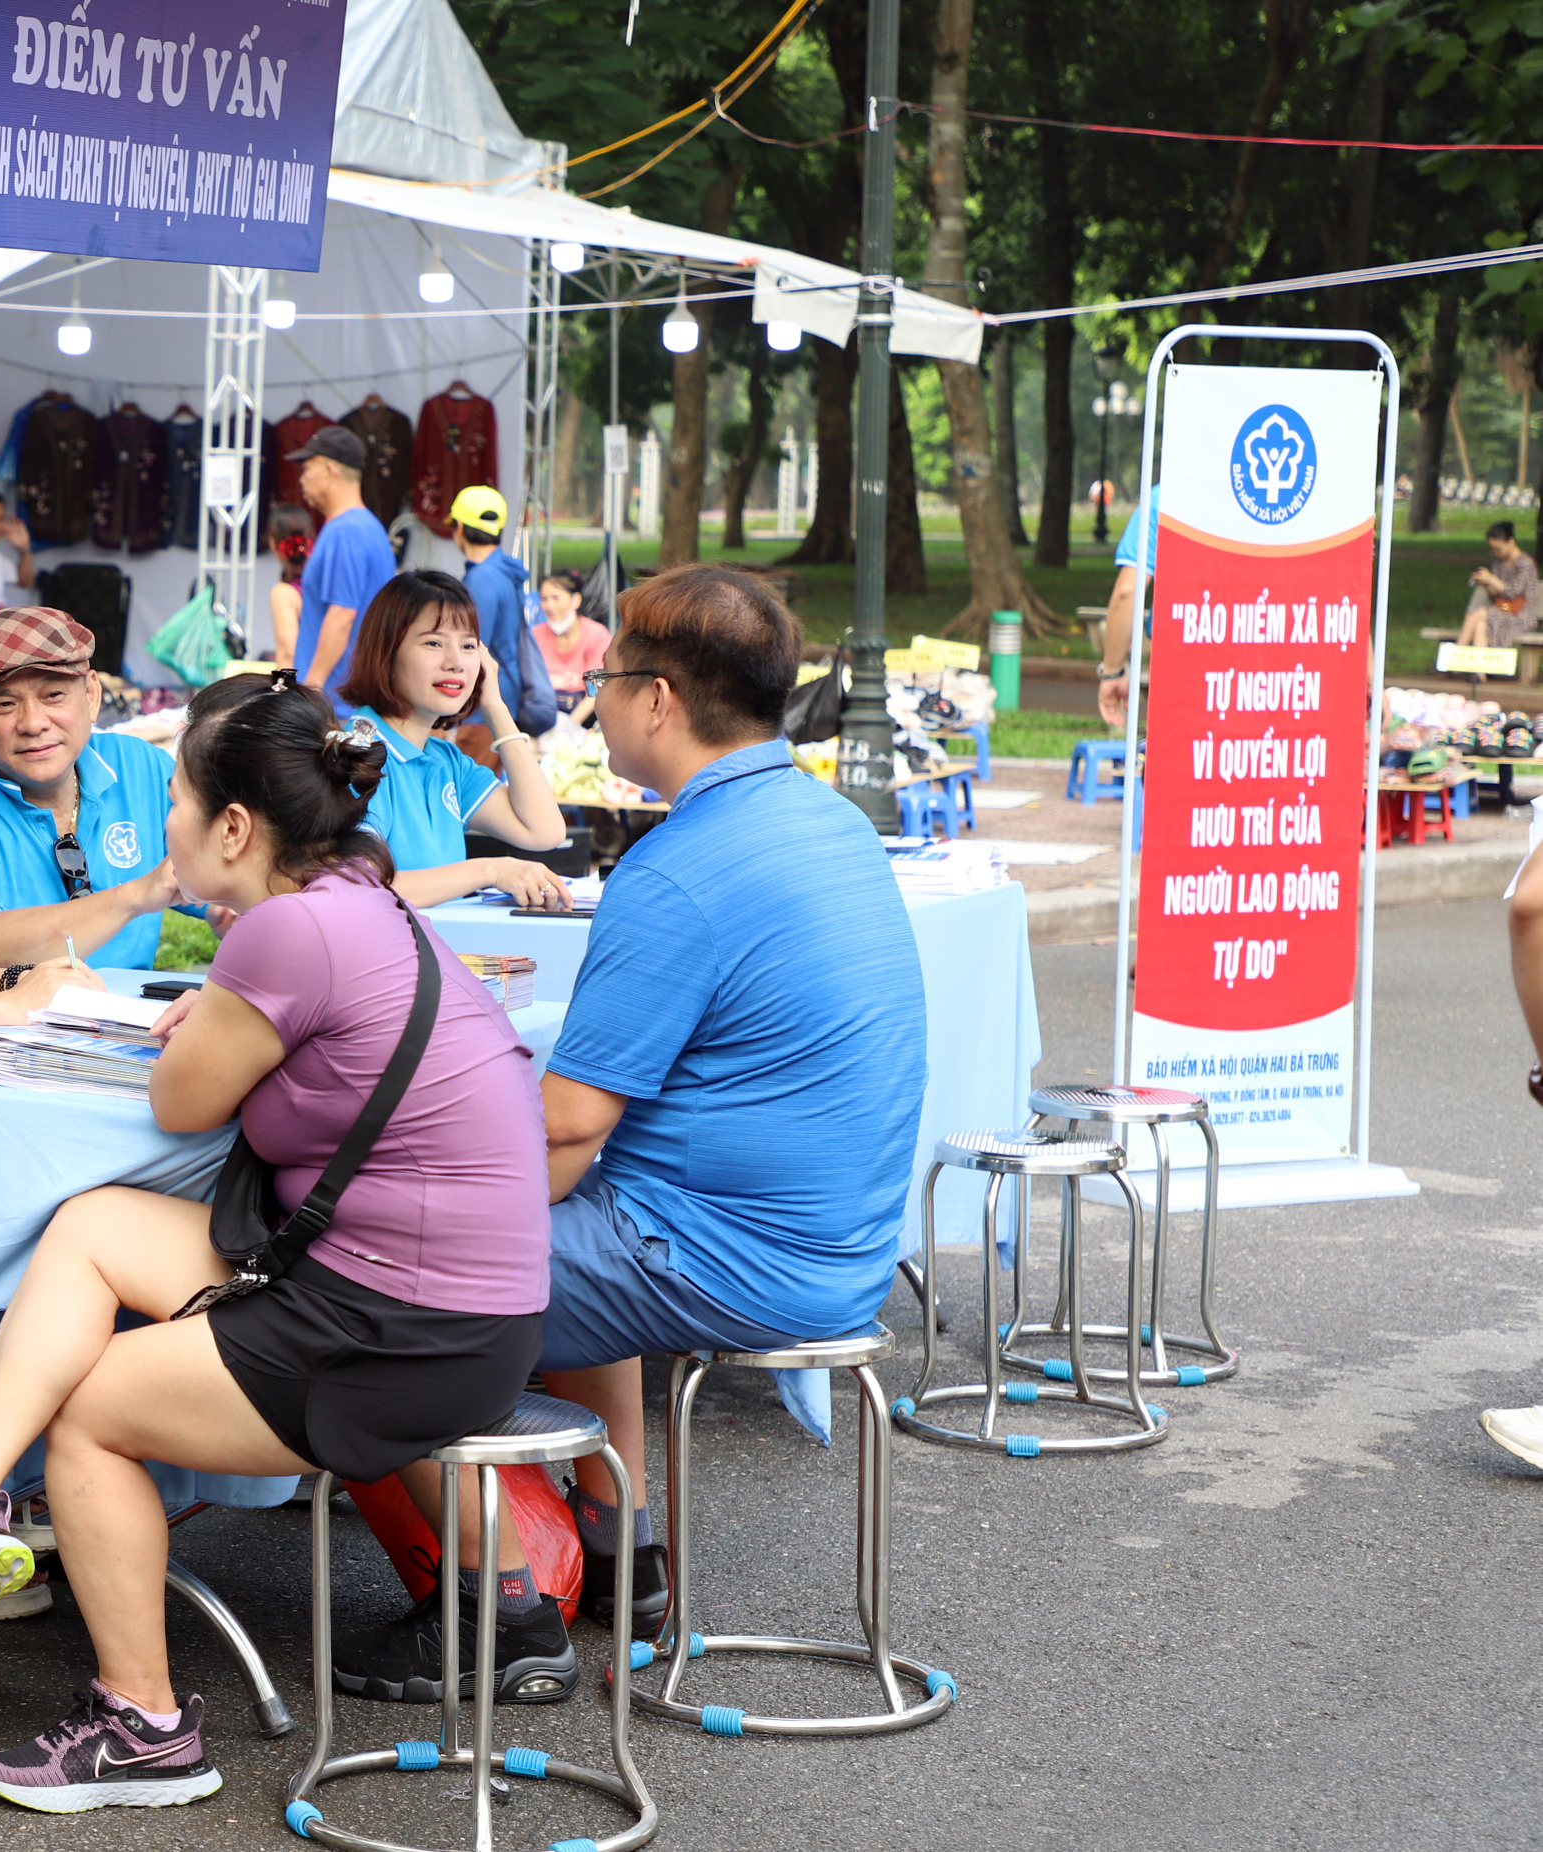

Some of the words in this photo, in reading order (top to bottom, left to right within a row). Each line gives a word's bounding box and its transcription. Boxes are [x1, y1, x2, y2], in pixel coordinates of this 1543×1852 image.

[135, 32, 196, 107] TƯ
[202, 24, 288, 121] VẤN
[14, 114, 60, 200] SÁCH
[60, 133, 105, 206] BHXH
[108, 135, 131, 222] TỰ
[127, 133, 190, 227] NGUYỆN,
[193, 150, 232, 218] BHYT
[230, 142, 254, 233] HỘ
[253, 156, 278, 222] GIA
[277, 148, 315, 226] ĐÌNH
[1232, 463, 1245, 491] BẢO
[1238, 489, 1259, 516] HIỂM
[1286, 490, 1305, 515] VIỆT
[1301, 464, 1315, 494] NAM
[1257, 506, 1271, 522] XÃ
[1272, 506, 1288, 523] HỘI
[1172, 590, 1227, 644] "BẢO
[1232, 587, 1286, 644] HIỂM
[1290, 597, 1319, 644] XÃ
[1324, 595, 1358, 652] HỘI
[1205, 667, 1234, 720] TỰ
[1236, 663, 1321, 719] NGUYỆN
[1192, 731, 1214, 780] VÌ
[1218, 726, 1288, 784] QUYỀN
[1293, 734, 1326, 786] LỢI
[1191, 803, 1235, 847] HƯU
[1241, 797, 1275, 846] TRÍ
[1279, 792, 1322, 845] CỦA
[1164, 864, 1232, 915] NGƯỜI
[1237, 872, 1278, 913] LAO
[1282, 863, 1339, 920] ĐỘNG
[1213, 936, 1243, 989] TỰ
[1245, 938, 1287, 980] DO"
[1146, 1055, 1167, 1079] BẢO
[1170, 1051, 1197, 1078] HIỂM
[1201, 1055, 1216, 1076] XÃ
[1219, 1056, 1237, 1080] HỘI
[1240, 1053, 1268, 1079] QUẬN
[1269, 1055, 1287, 1074] HAI
[1290, 1051, 1304, 1072] BÀ
[1307, 1052, 1340, 1071] TRƯNG
